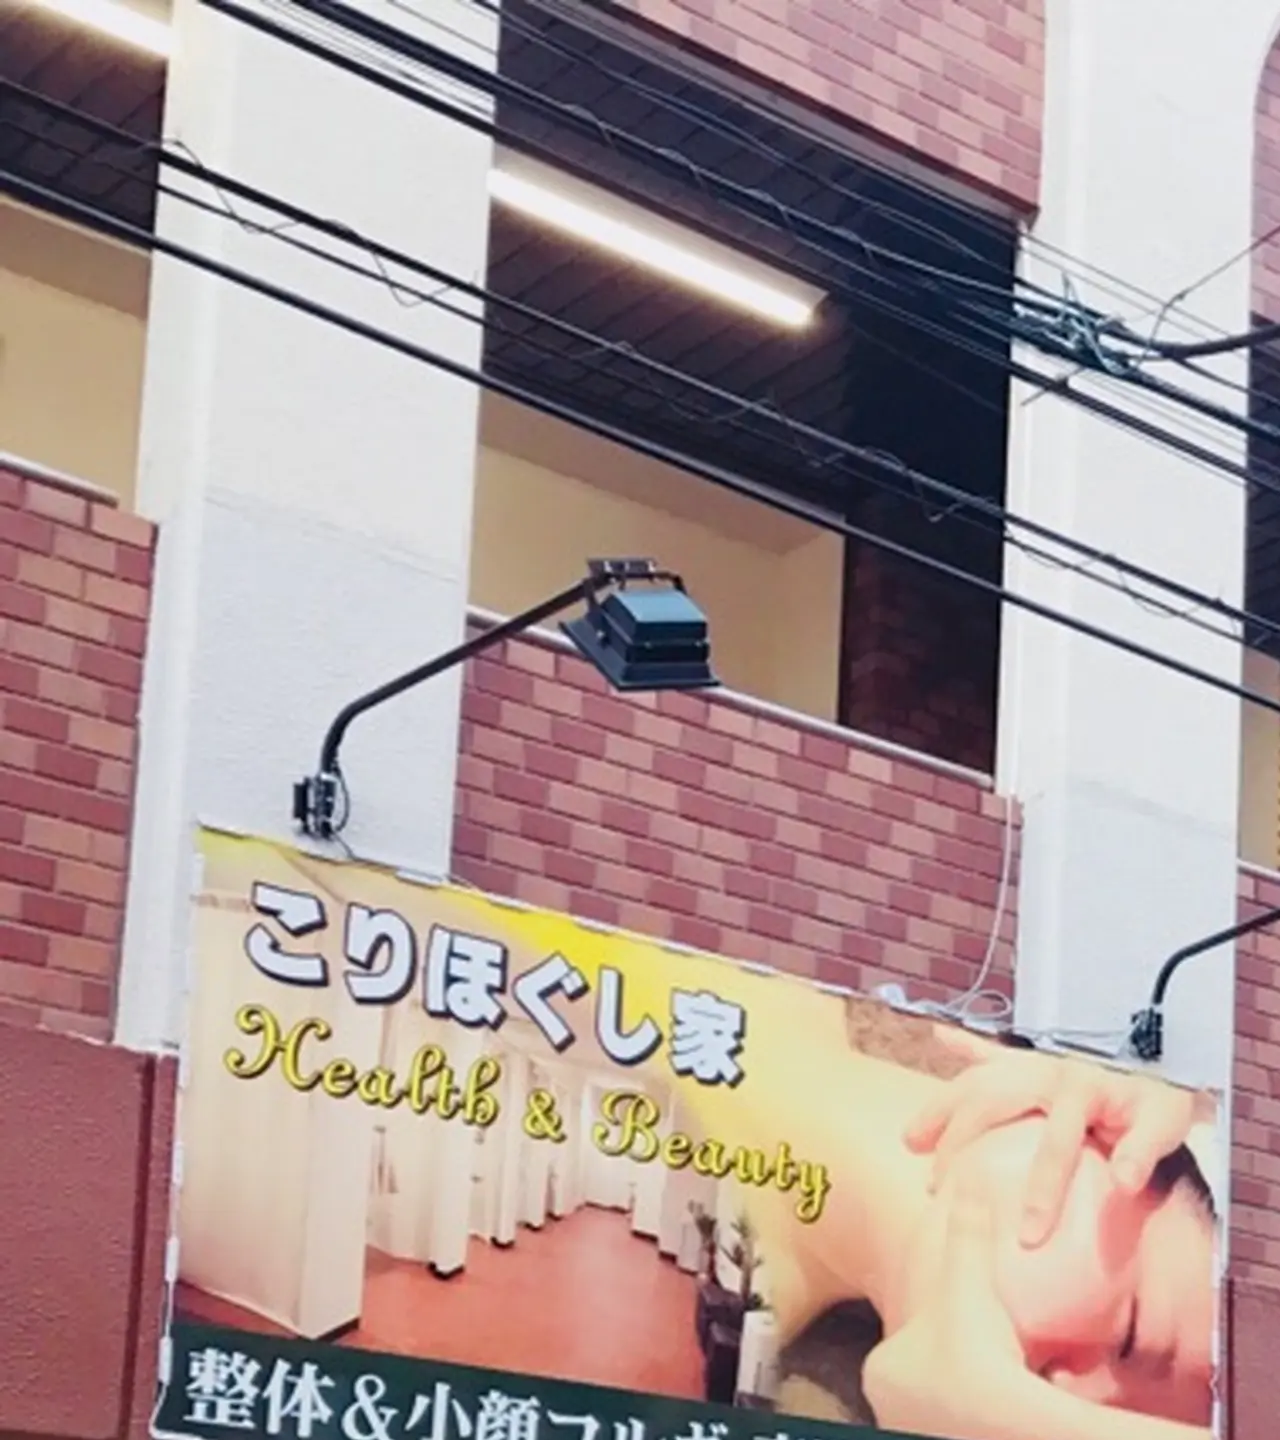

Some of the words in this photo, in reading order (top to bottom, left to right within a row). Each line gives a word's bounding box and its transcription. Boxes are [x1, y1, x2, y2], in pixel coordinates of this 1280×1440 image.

[243, 880, 747, 1087] こりほぐし家
[224, 1004, 500, 1129] Health
[523, 1090, 566, 1143] &
[591, 1090, 831, 1222] Beauty
